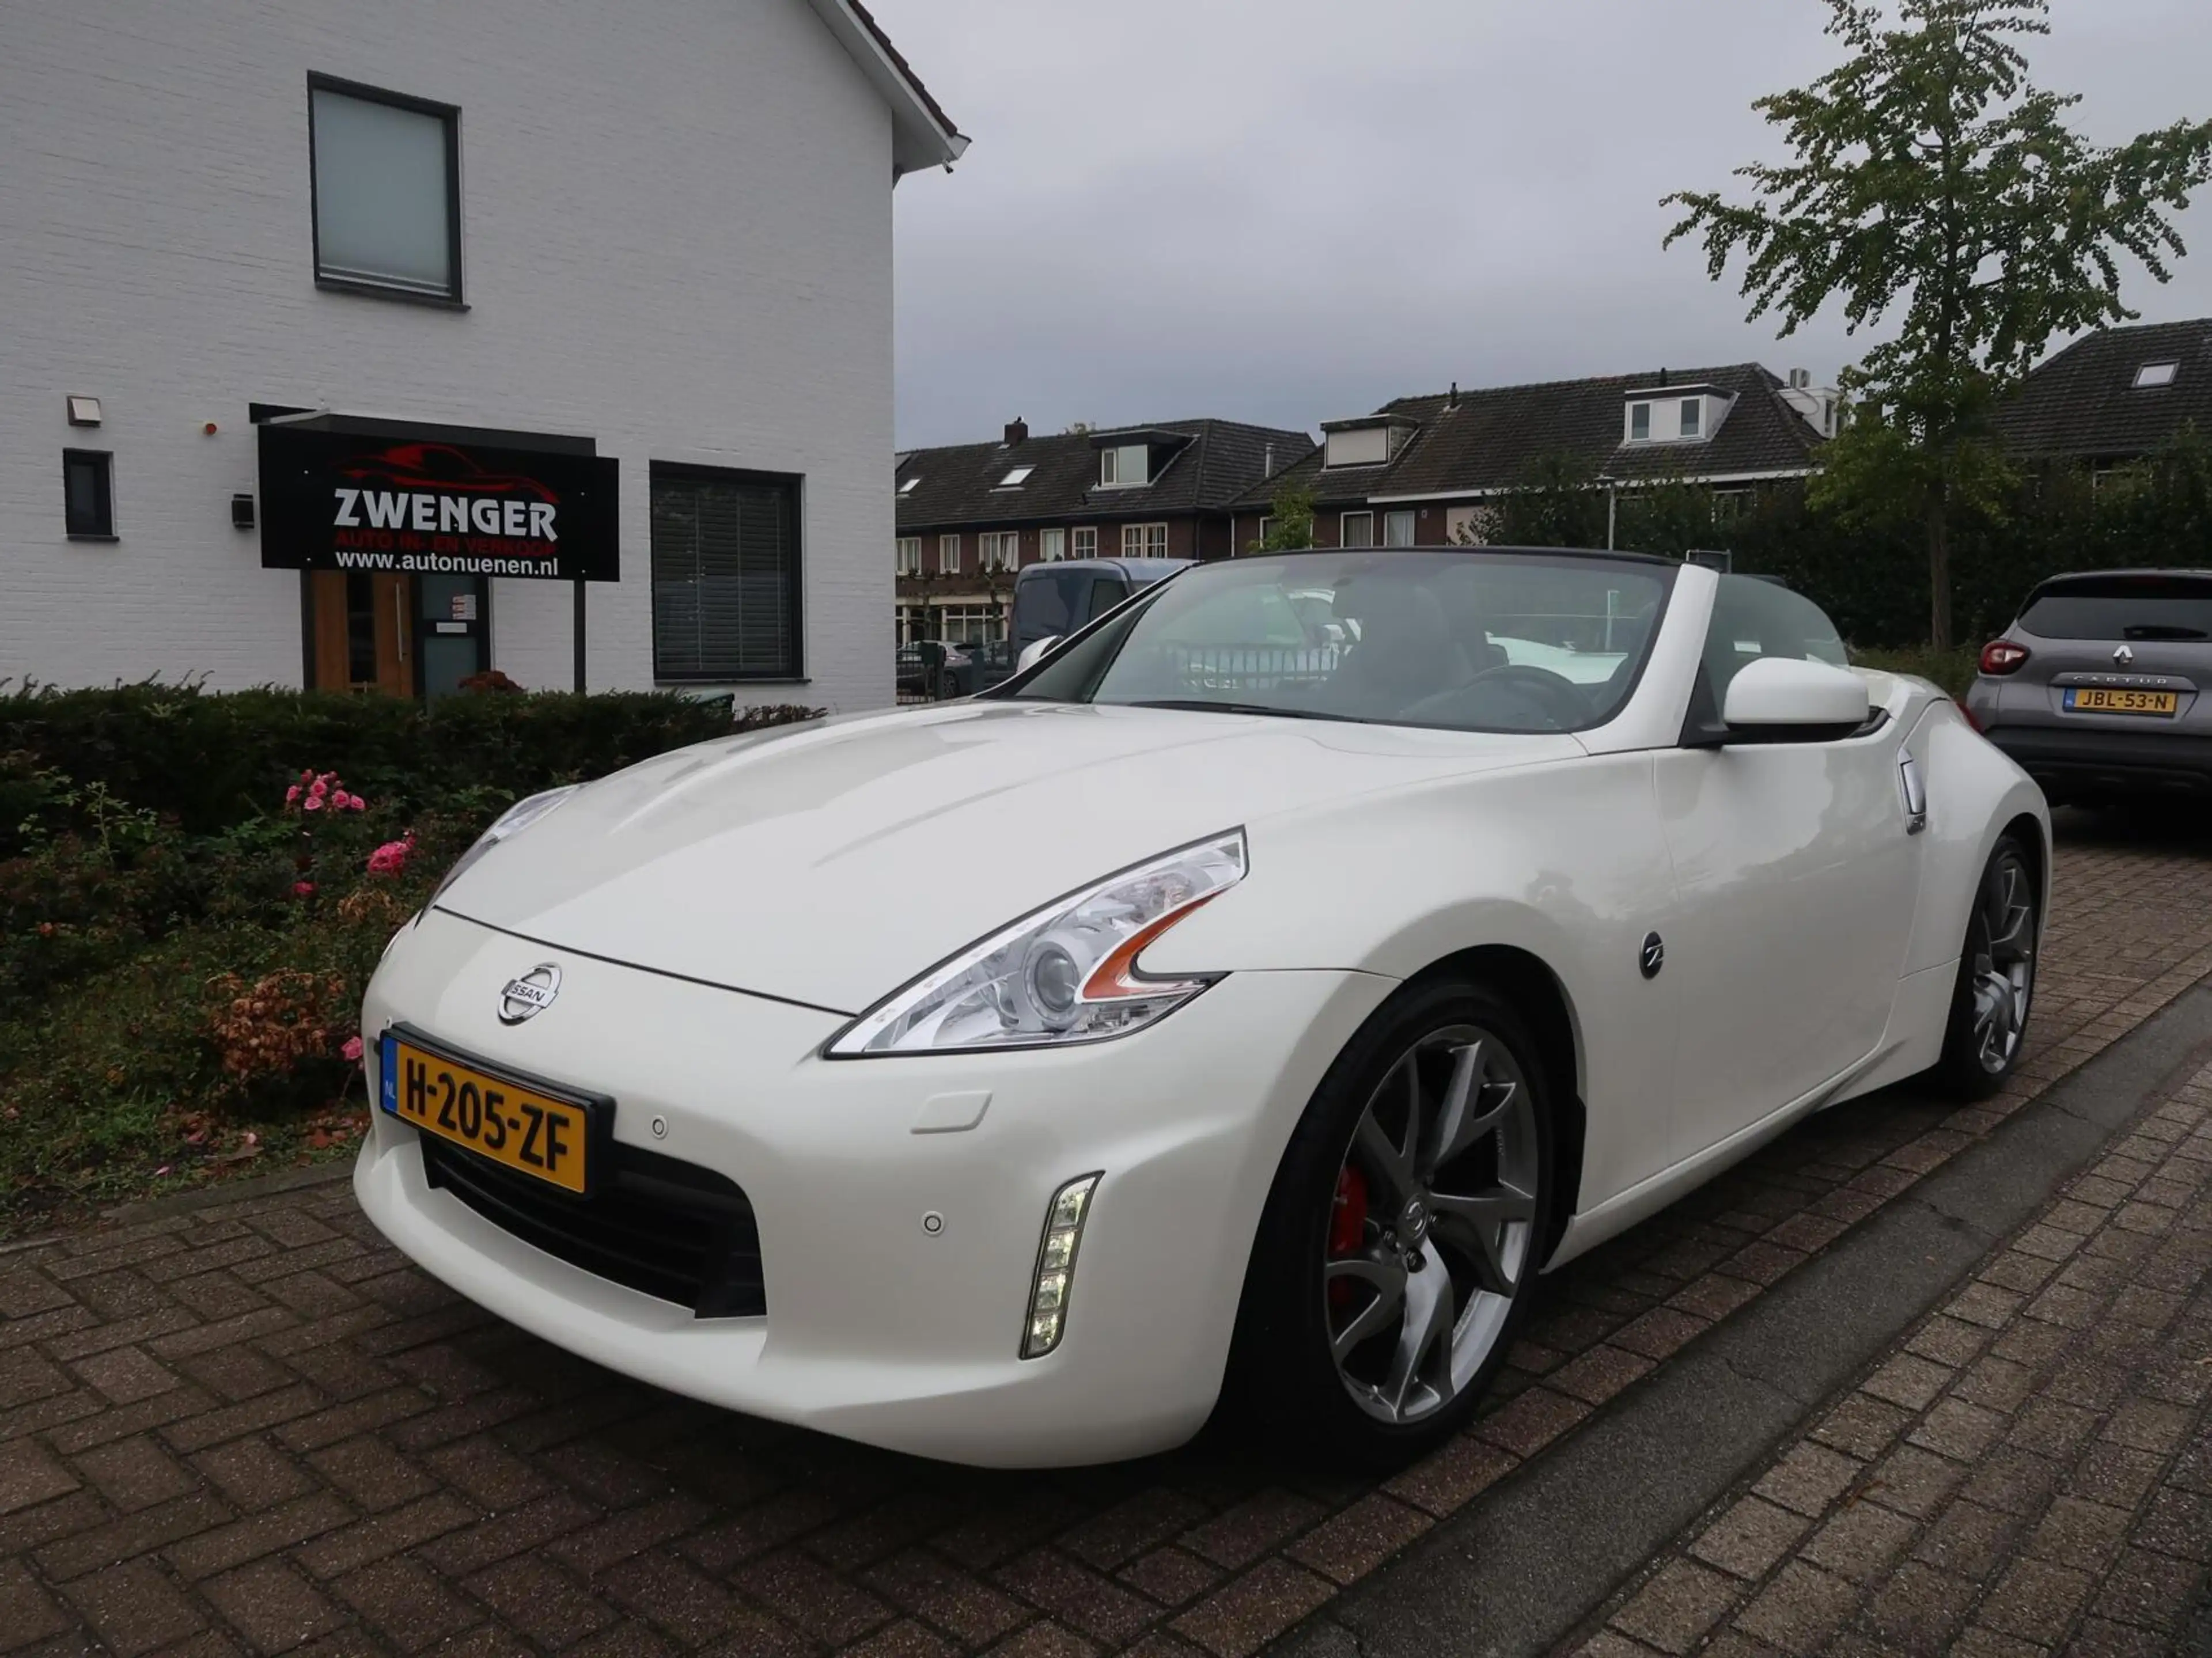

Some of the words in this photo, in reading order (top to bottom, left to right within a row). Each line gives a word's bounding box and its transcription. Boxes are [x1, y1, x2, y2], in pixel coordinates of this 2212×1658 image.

[334, 488, 558, 542] ZWENGER
[335, 532, 393, 549] AUTO
[433, 536, 460, 553] EN
[335, 552, 558, 576] www.autonuenen.nl
[2082, 691, 2168, 710] JBL-53-N
[406, 1057, 570, 1172] H-205-ZF
